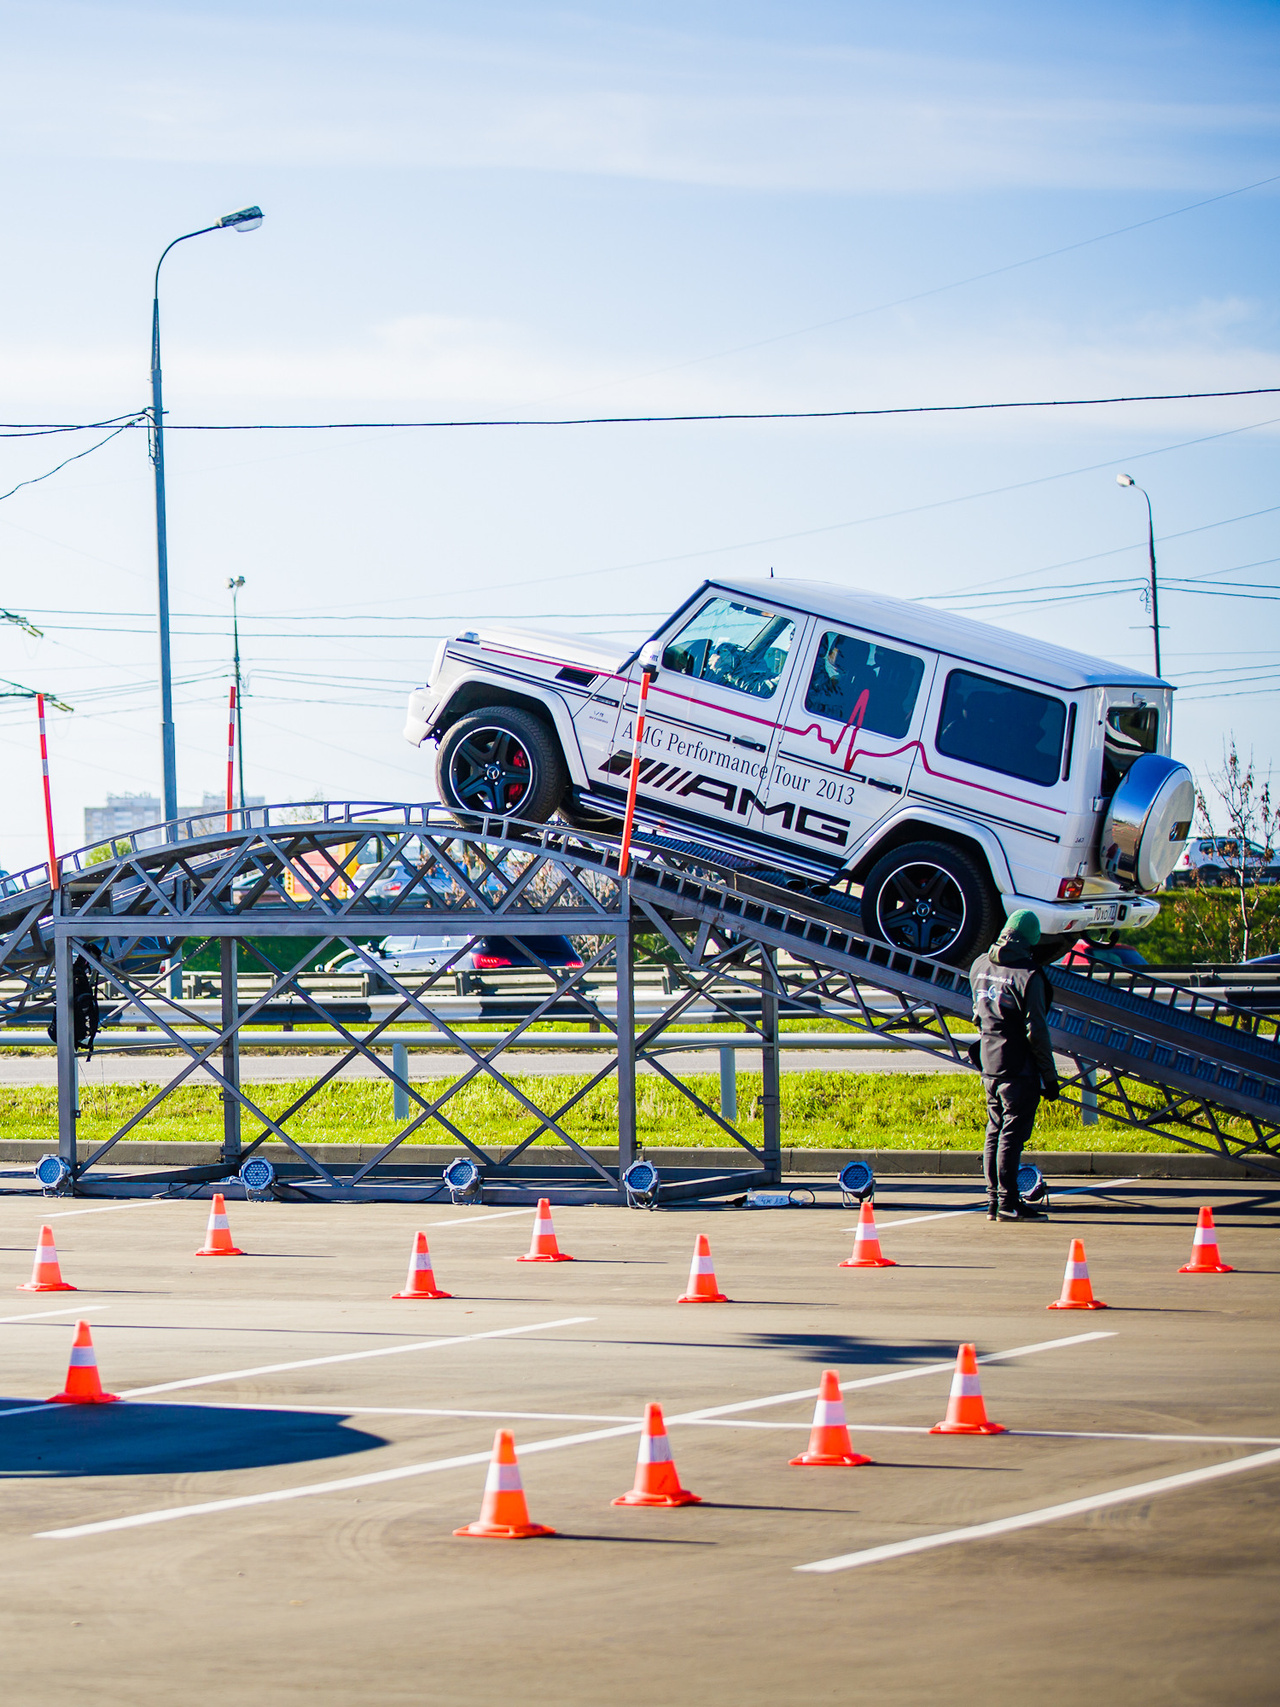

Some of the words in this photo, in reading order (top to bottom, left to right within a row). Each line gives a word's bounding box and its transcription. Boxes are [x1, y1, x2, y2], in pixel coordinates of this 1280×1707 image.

[666, 732, 768, 780] Performance
[775, 764, 811, 792] Tour
[815, 778, 855, 806] 2013
[675, 774, 851, 847] AMG
